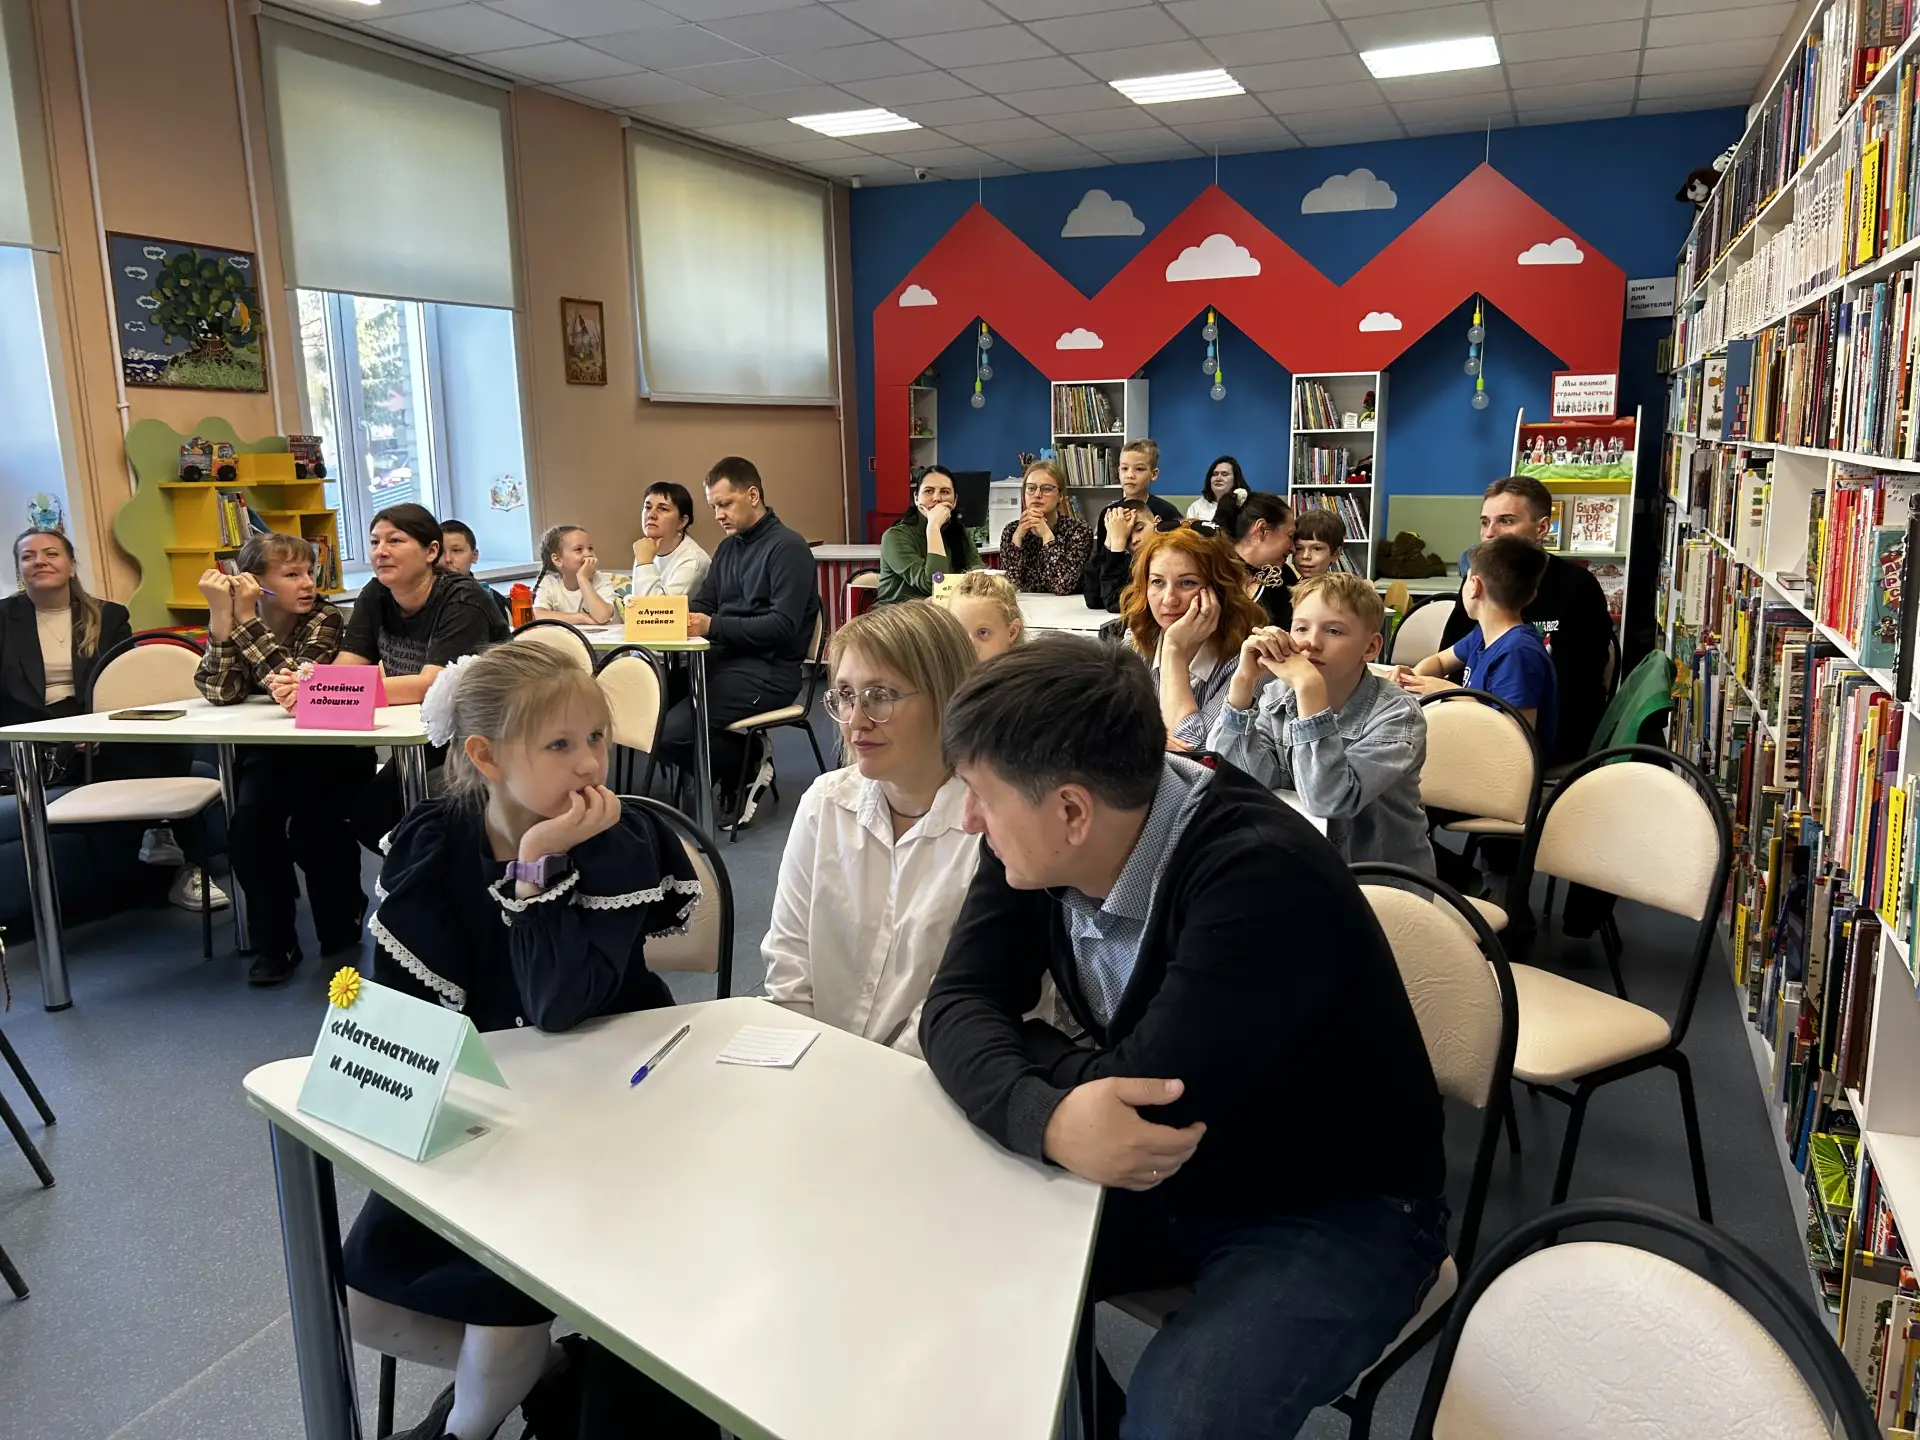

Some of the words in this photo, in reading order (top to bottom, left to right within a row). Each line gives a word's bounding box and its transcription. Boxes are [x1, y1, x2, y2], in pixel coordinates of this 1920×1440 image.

[1867, 161, 1876, 241] ПРОФЕССИИ
[1631, 301, 1673, 309] РОДИТЕЛЕЙ
[636, 617, 675, 625] семейка»
[309, 682, 365, 692] «Семейные
[310, 696, 360, 706] ладошки»
[1886, 813, 1898, 913] ПСИХОЛОГИЯ
[331, 1018, 441, 1076] «Математики
[329, 1054, 342, 1071] и
[342, 1060, 414, 1102] лирики»
